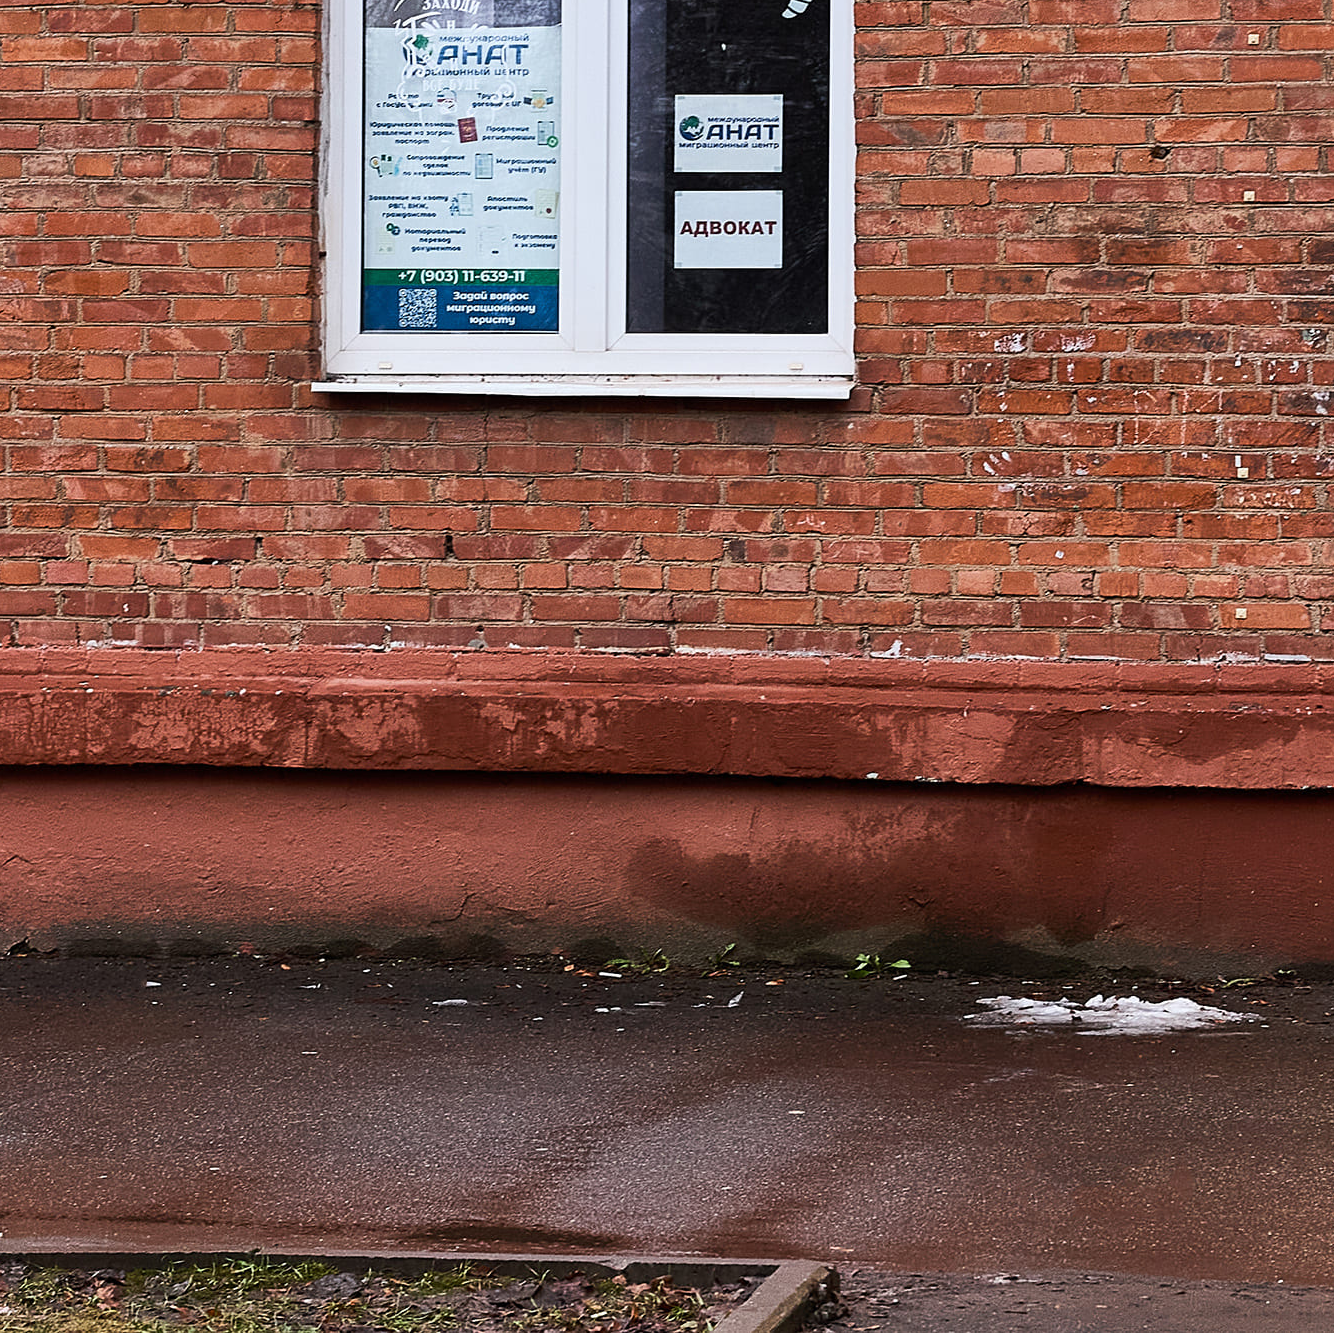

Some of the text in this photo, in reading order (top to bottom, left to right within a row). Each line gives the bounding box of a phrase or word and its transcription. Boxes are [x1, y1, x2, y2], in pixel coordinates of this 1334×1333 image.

[680, 221, 777, 237] АДВОКАТ
[398, 270, 525, 284] +7 (903) 11-639-11
[453, 291, 529, 302] Задай вопрос
[446, 304, 536, 313] миграционному
[469, 316, 515, 325] юристу
